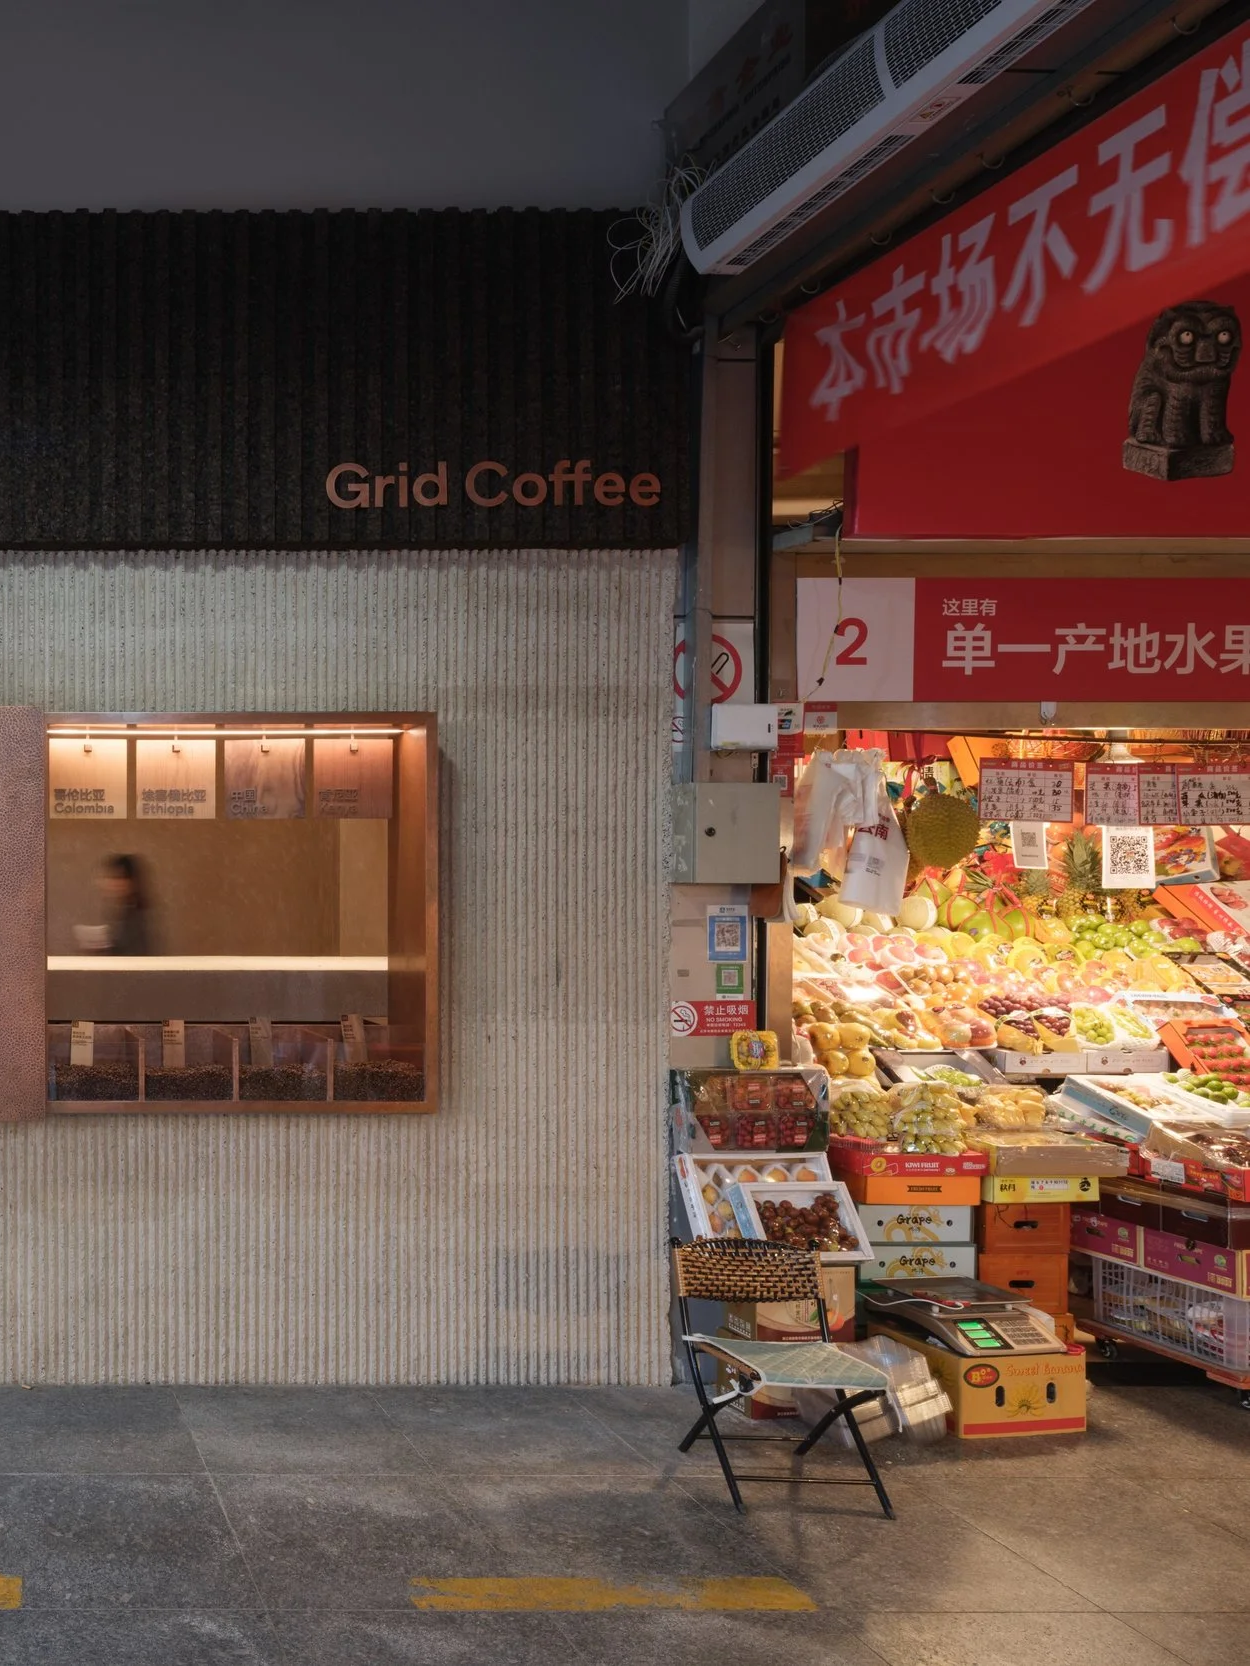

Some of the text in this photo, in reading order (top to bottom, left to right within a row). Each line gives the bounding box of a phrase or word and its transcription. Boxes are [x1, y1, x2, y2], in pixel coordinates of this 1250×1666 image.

[325, 459, 661, 509] Grid Coffee
[942, 598, 997, 617] 这里有
[835, 617, 868, 666] 2
[942, 622, 1250, 675] 单一产地水果
[54, 788, 106, 801] 哥伦比亚
[141, 788, 206, 802] 埃塞俄比亚
[230, 788, 258, 802] 中国
[54, 802, 115, 814] Colombia
[141, 802, 195, 816] Ethiopia
[230, 803, 268, 815] China
[319, 803, 358, 816] Kenya
[704, 1005, 749, 1016] 禁止吸烟
[896, 1214, 933, 1227] Grape
[900, 1255, 936, 1268] Grape
